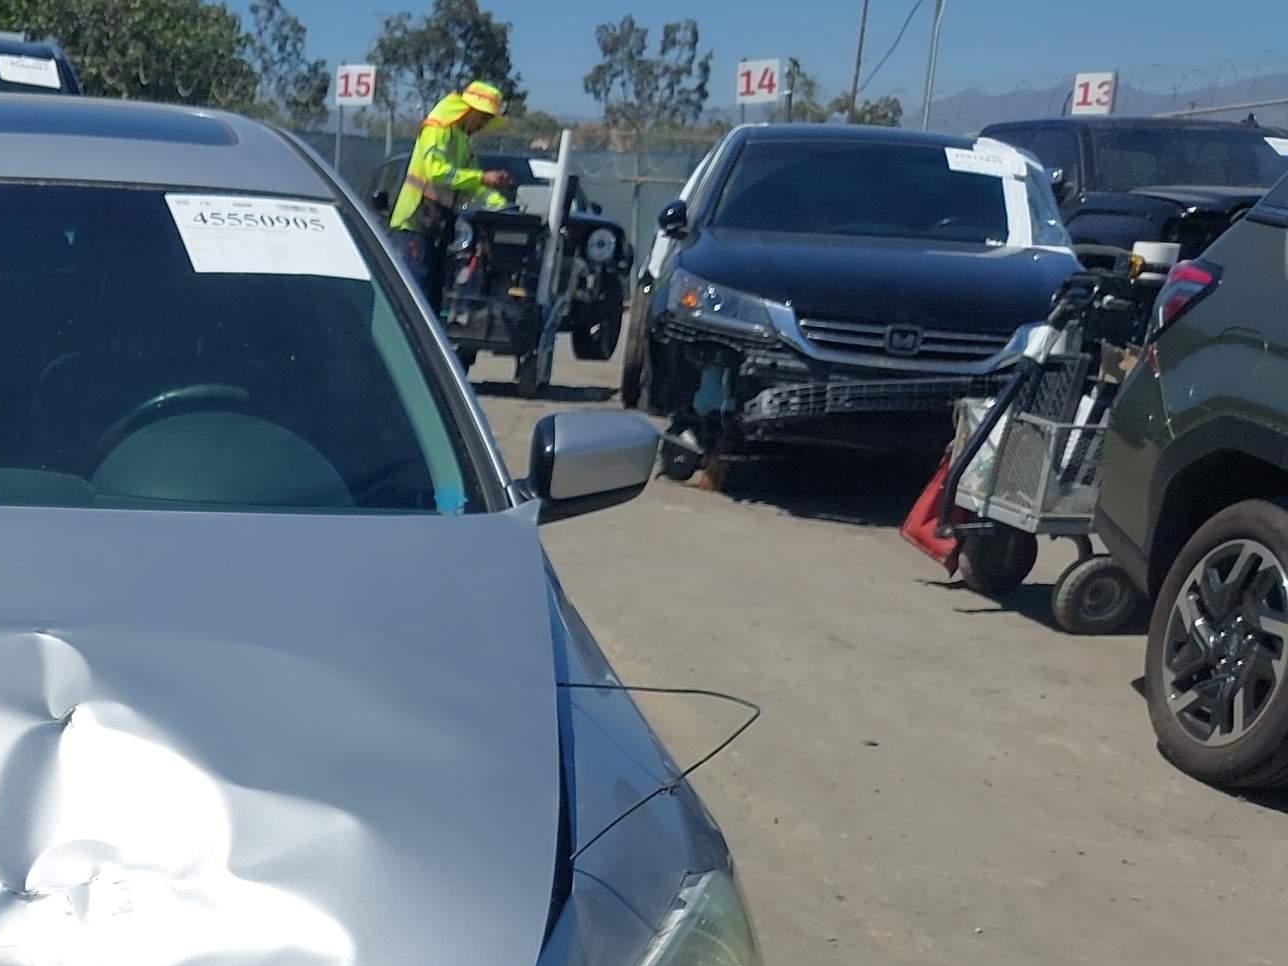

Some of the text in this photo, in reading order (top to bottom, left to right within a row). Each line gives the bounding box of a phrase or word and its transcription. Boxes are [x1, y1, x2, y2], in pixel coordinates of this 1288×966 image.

[338, 72, 371, 98] 15
[739, 67, 777, 97] 14
[1076, 80, 1112, 107] 13
[193, 211, 326, 232] 45550905
